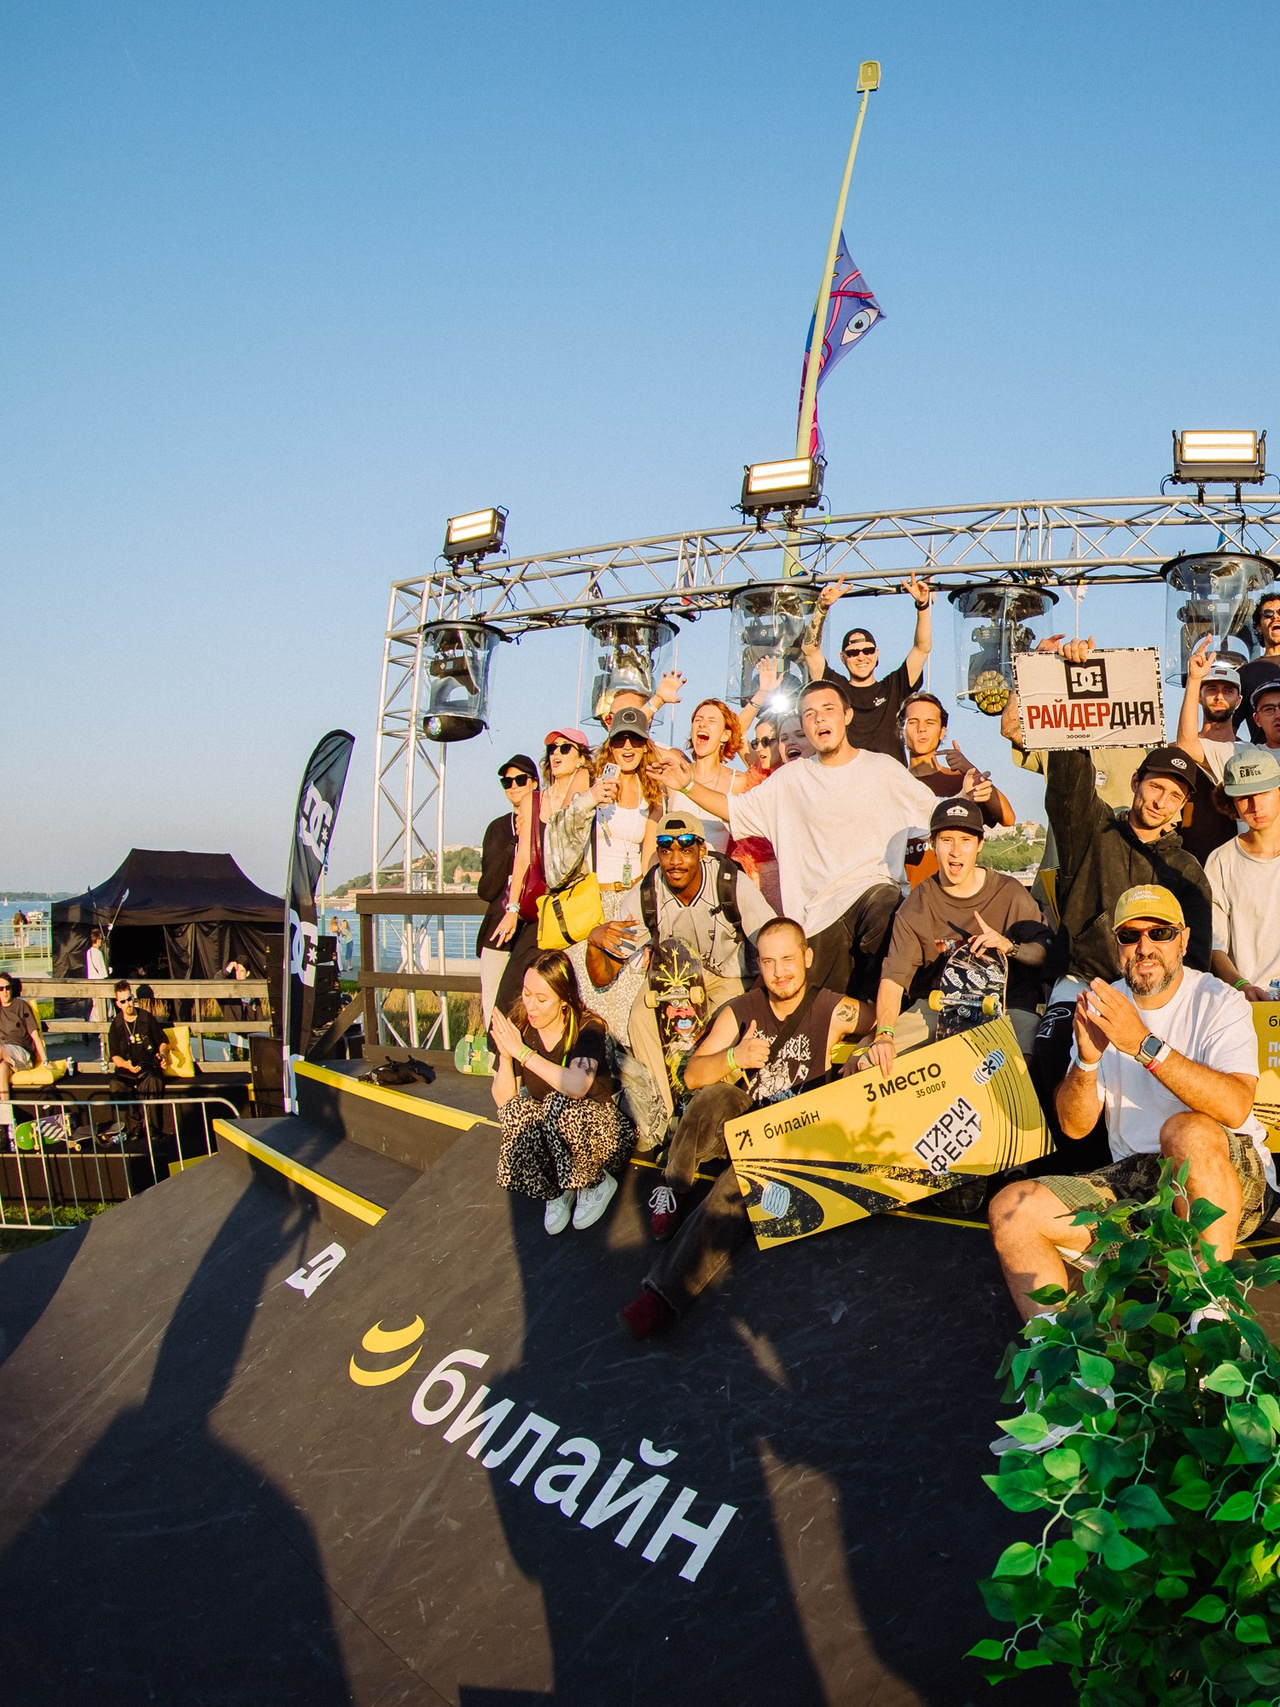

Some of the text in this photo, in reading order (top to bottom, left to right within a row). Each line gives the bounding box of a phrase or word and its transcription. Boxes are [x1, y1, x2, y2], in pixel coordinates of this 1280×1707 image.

[1069, 665, 1104, 693] DC
[863, 1062, 942, 1102] 3 место
[763, 1109, 821, 1139] билайн
[931, 1113, 981, 1172] ФЕСТ
[411, 1349, 738, 1583] билайн
